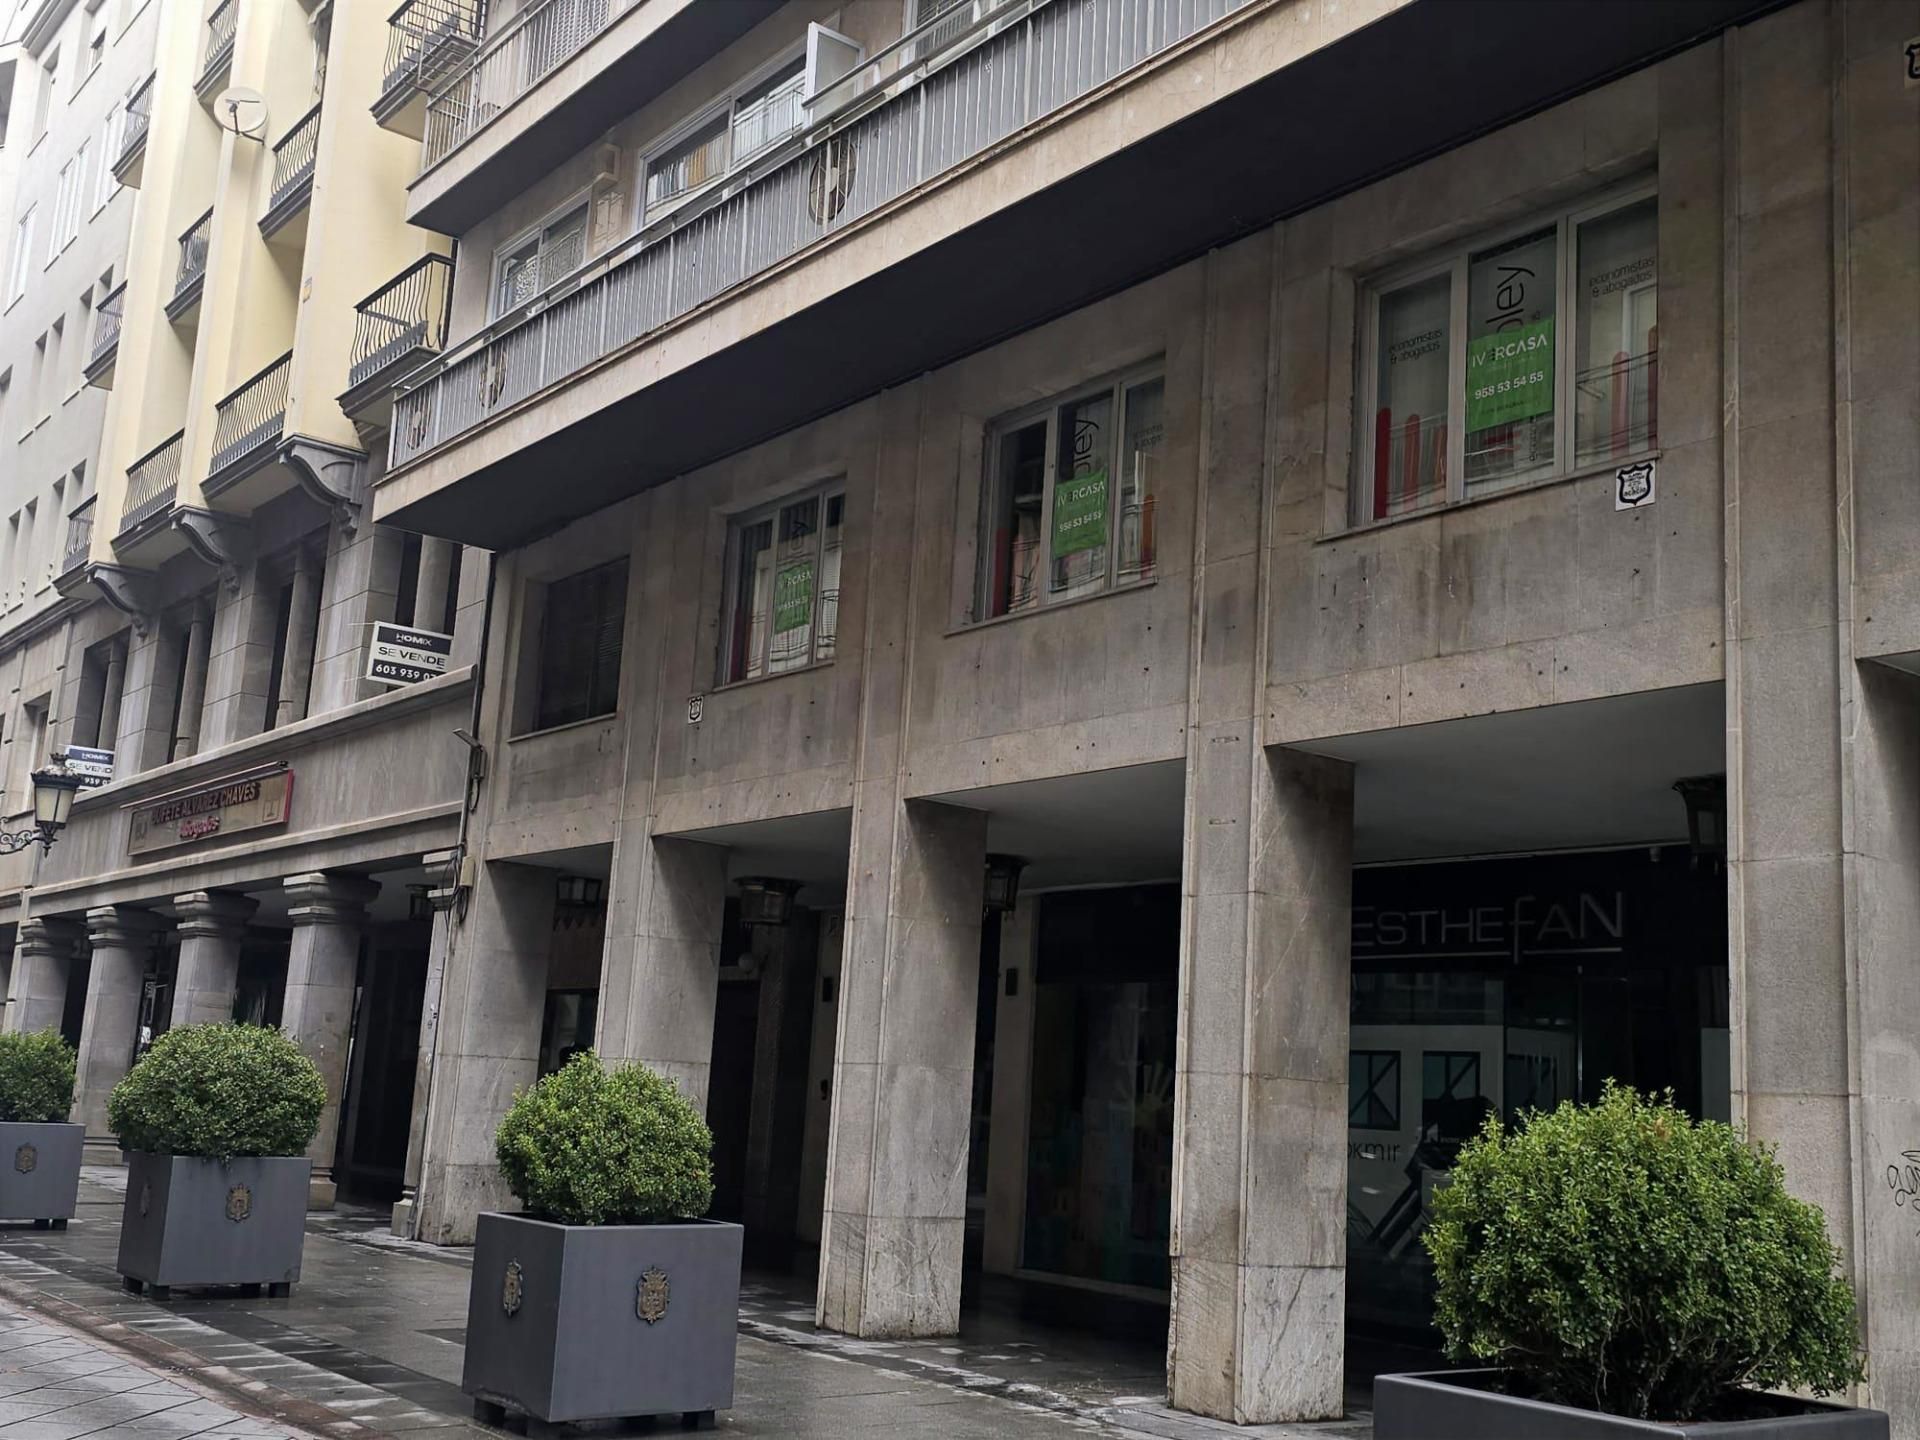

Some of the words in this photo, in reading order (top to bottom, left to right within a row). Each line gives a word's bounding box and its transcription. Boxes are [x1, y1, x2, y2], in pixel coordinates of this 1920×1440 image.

[1589, 256, 1655, 287] economistas
[1475, 385, 1495, 400] 958
[1497, 380, 1511, 393] 53
[1513, 376, 1527, 388] 54
[1529, 371, 1544, 384] 55
[378, 646, 396, 658] SE
[399, 650, 446, 667] VENDE
[375, 664, 397, 675] 603
[400, 668, 420, 680] 939
[84, 777, 101, 786] 939
[220, 781, 261, 807] CHAVES
